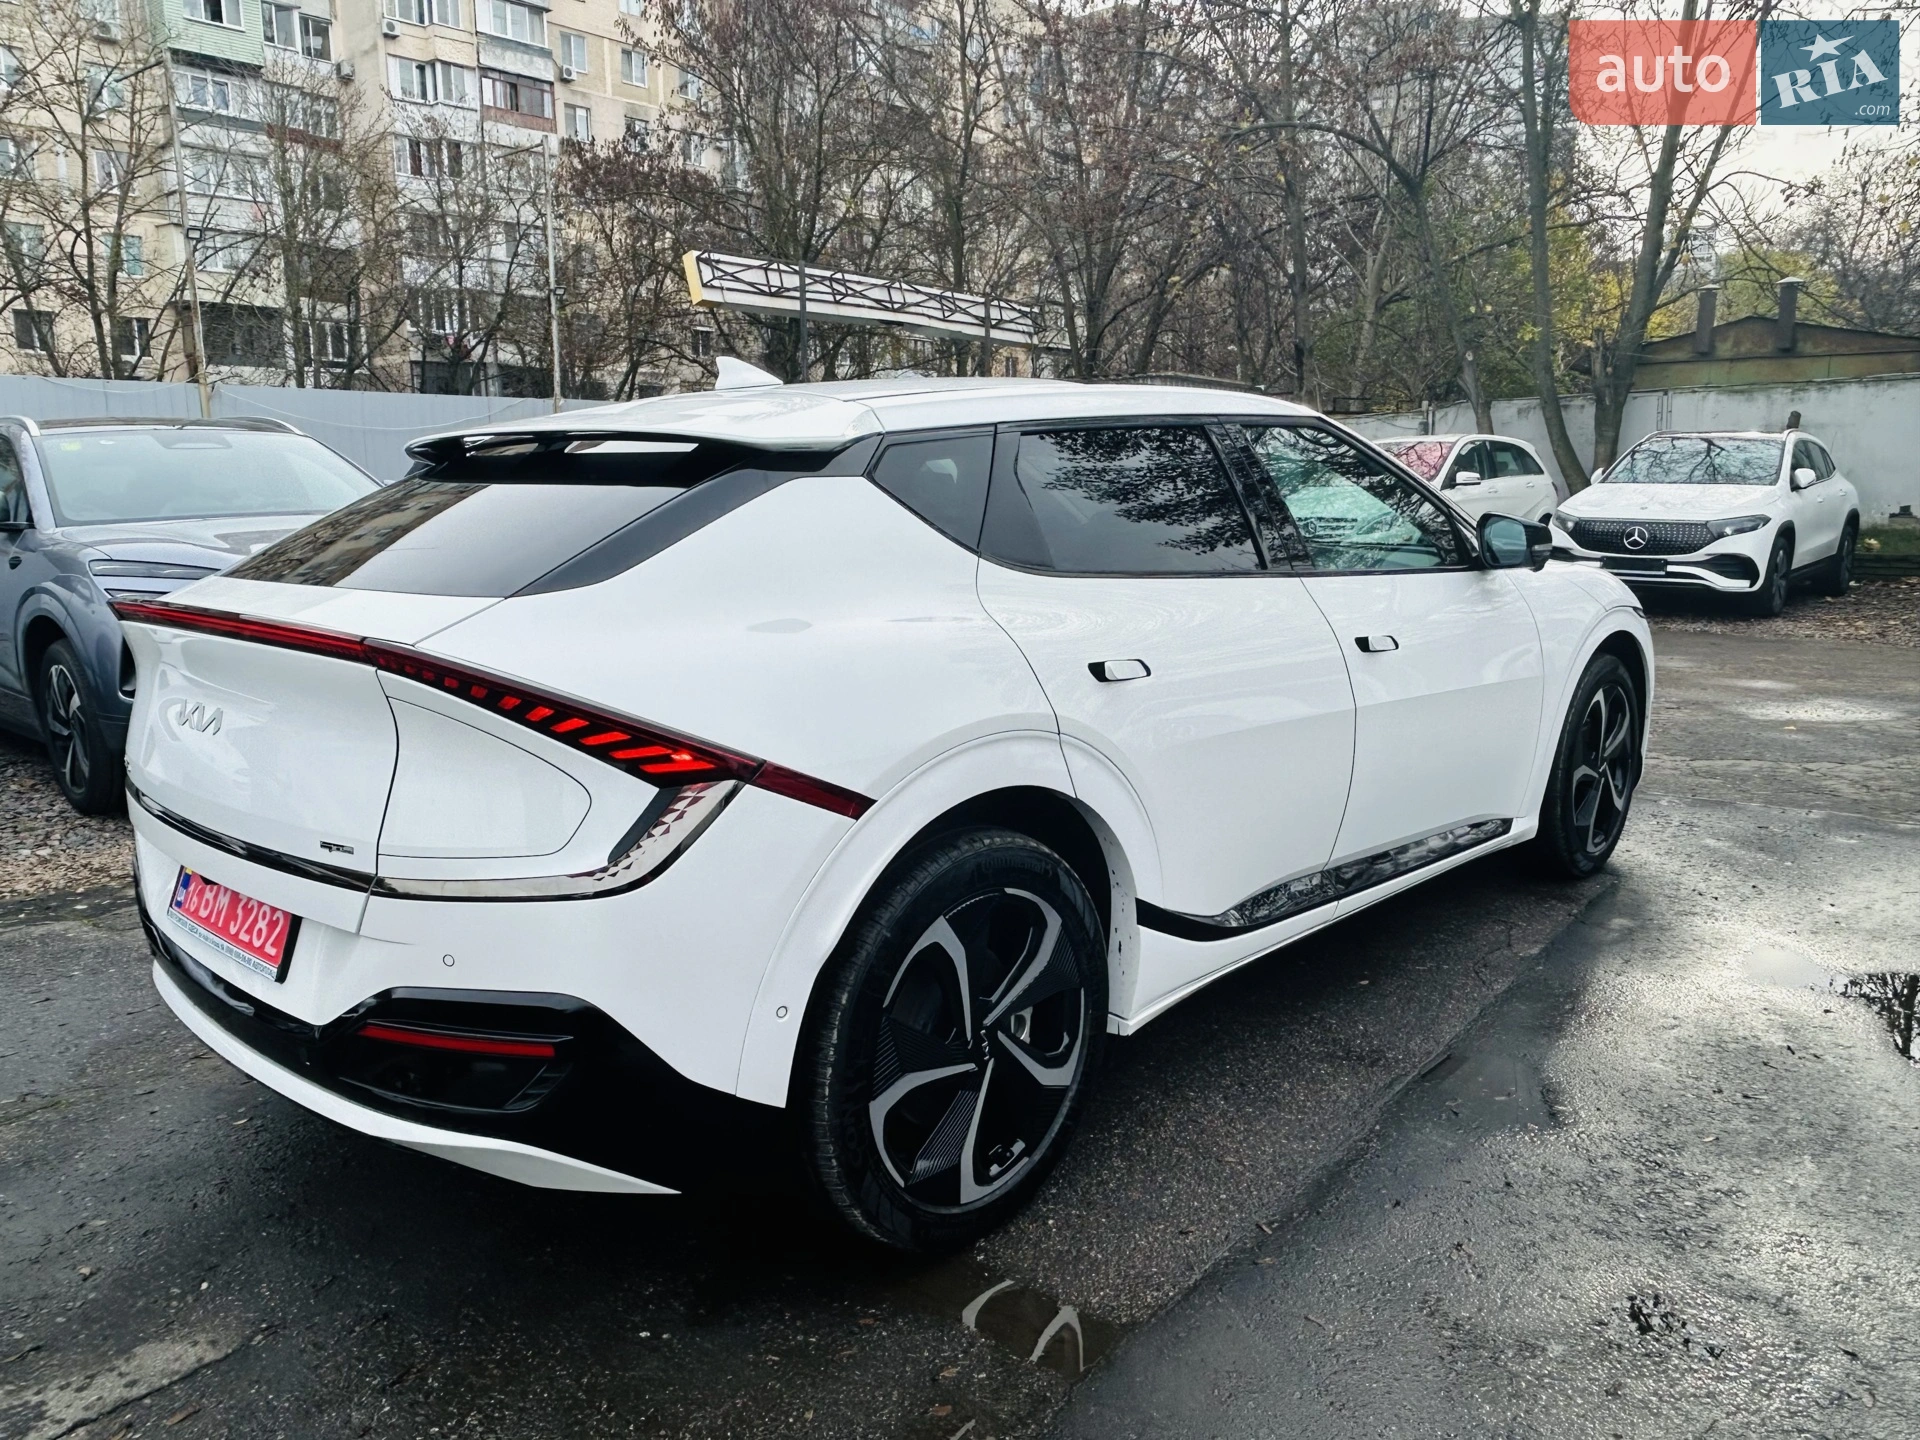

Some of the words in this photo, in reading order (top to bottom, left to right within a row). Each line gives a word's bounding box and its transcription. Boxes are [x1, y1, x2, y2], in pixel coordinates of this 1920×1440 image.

[185, 881, 203, 914] 16
[198, 884, 232, 928] BM
[229, 894, 285, 957] 3282
